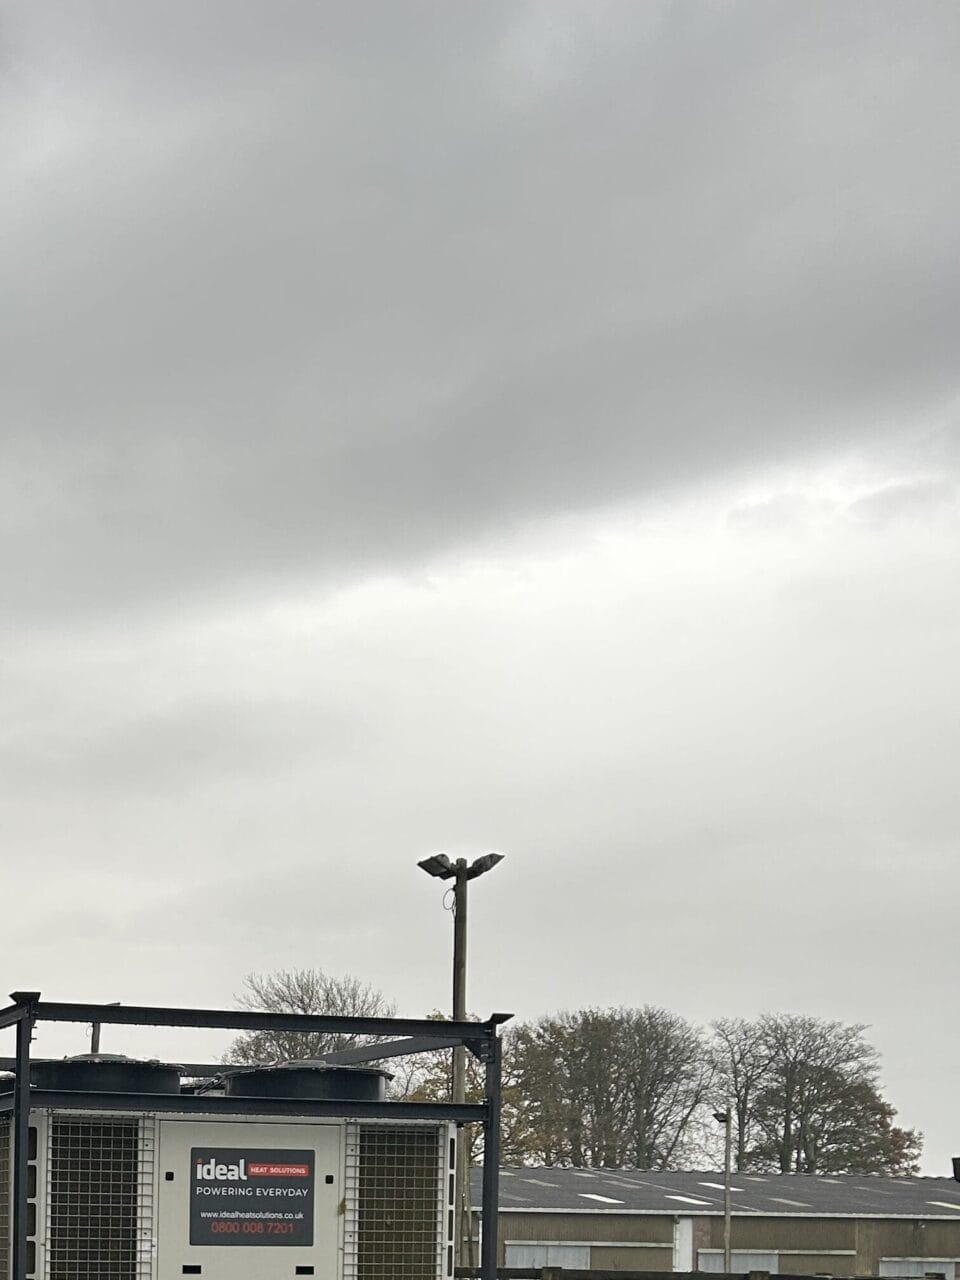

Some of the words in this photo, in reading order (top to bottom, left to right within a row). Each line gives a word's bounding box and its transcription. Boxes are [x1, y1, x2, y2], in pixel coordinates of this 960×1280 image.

[196, 1158, 247, 1180] ideal
[196, 1187, 253, 1196] POWERING
[256, 1188, 309, 1197] EVERYDAY
[200, 1211, 304, 1219] www.idealheatsolutions.co.uk
[211, 1222, 239, 1233] 0800
[267, 1222, 294, 1233] 7201
